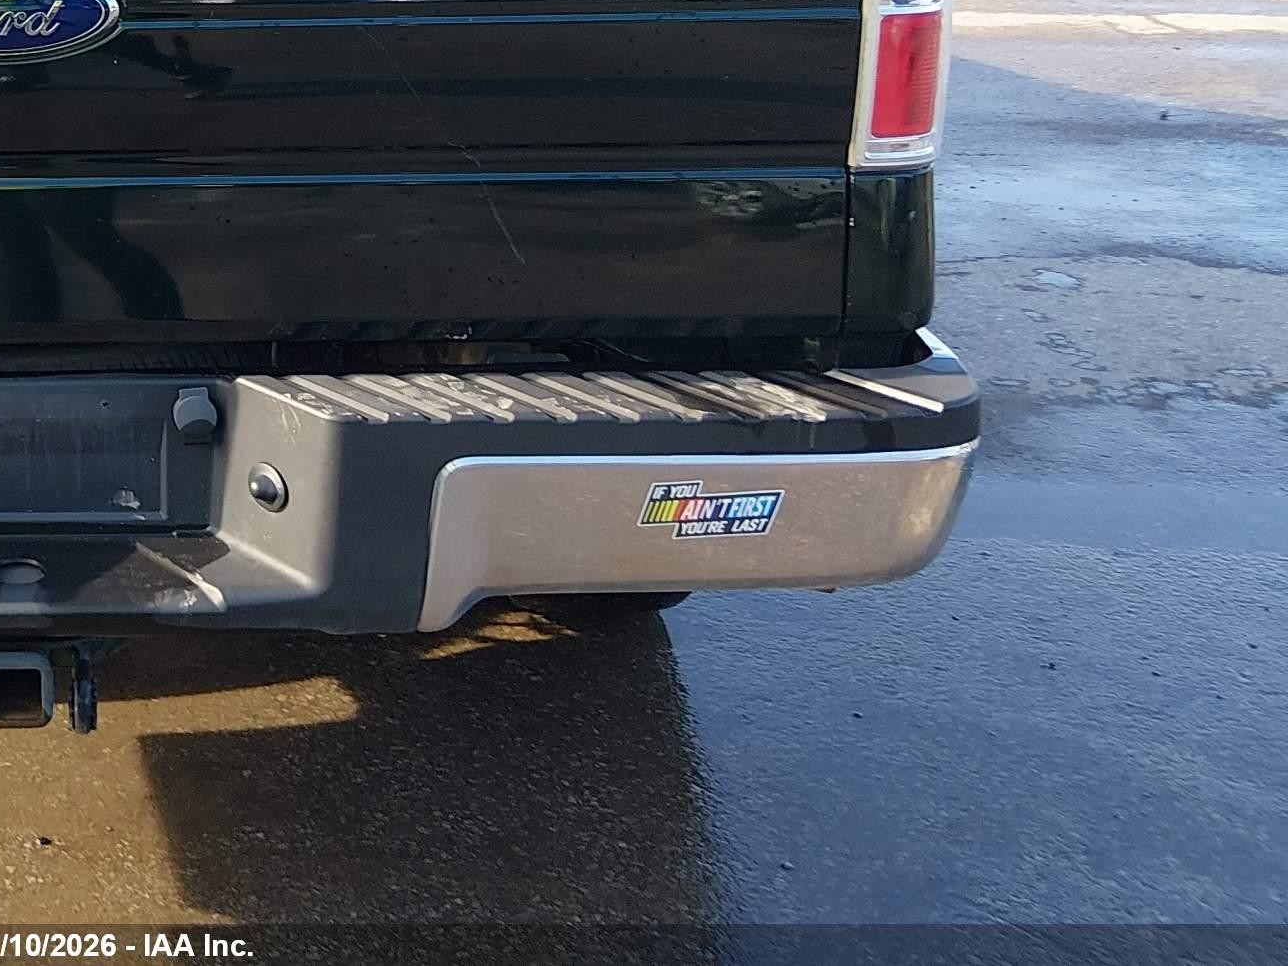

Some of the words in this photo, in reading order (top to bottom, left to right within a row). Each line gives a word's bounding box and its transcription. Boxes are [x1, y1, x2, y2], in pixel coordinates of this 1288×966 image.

[652, 486, 669, 500] IF
[670, 484, 698, 499] YOU
[680, 498, 732, 521] AIN'T
[729, 495, 777, 519] FIRST
[680, 520, 729, 535] YOU'RE
[731, 518, 769, 533] LAST
